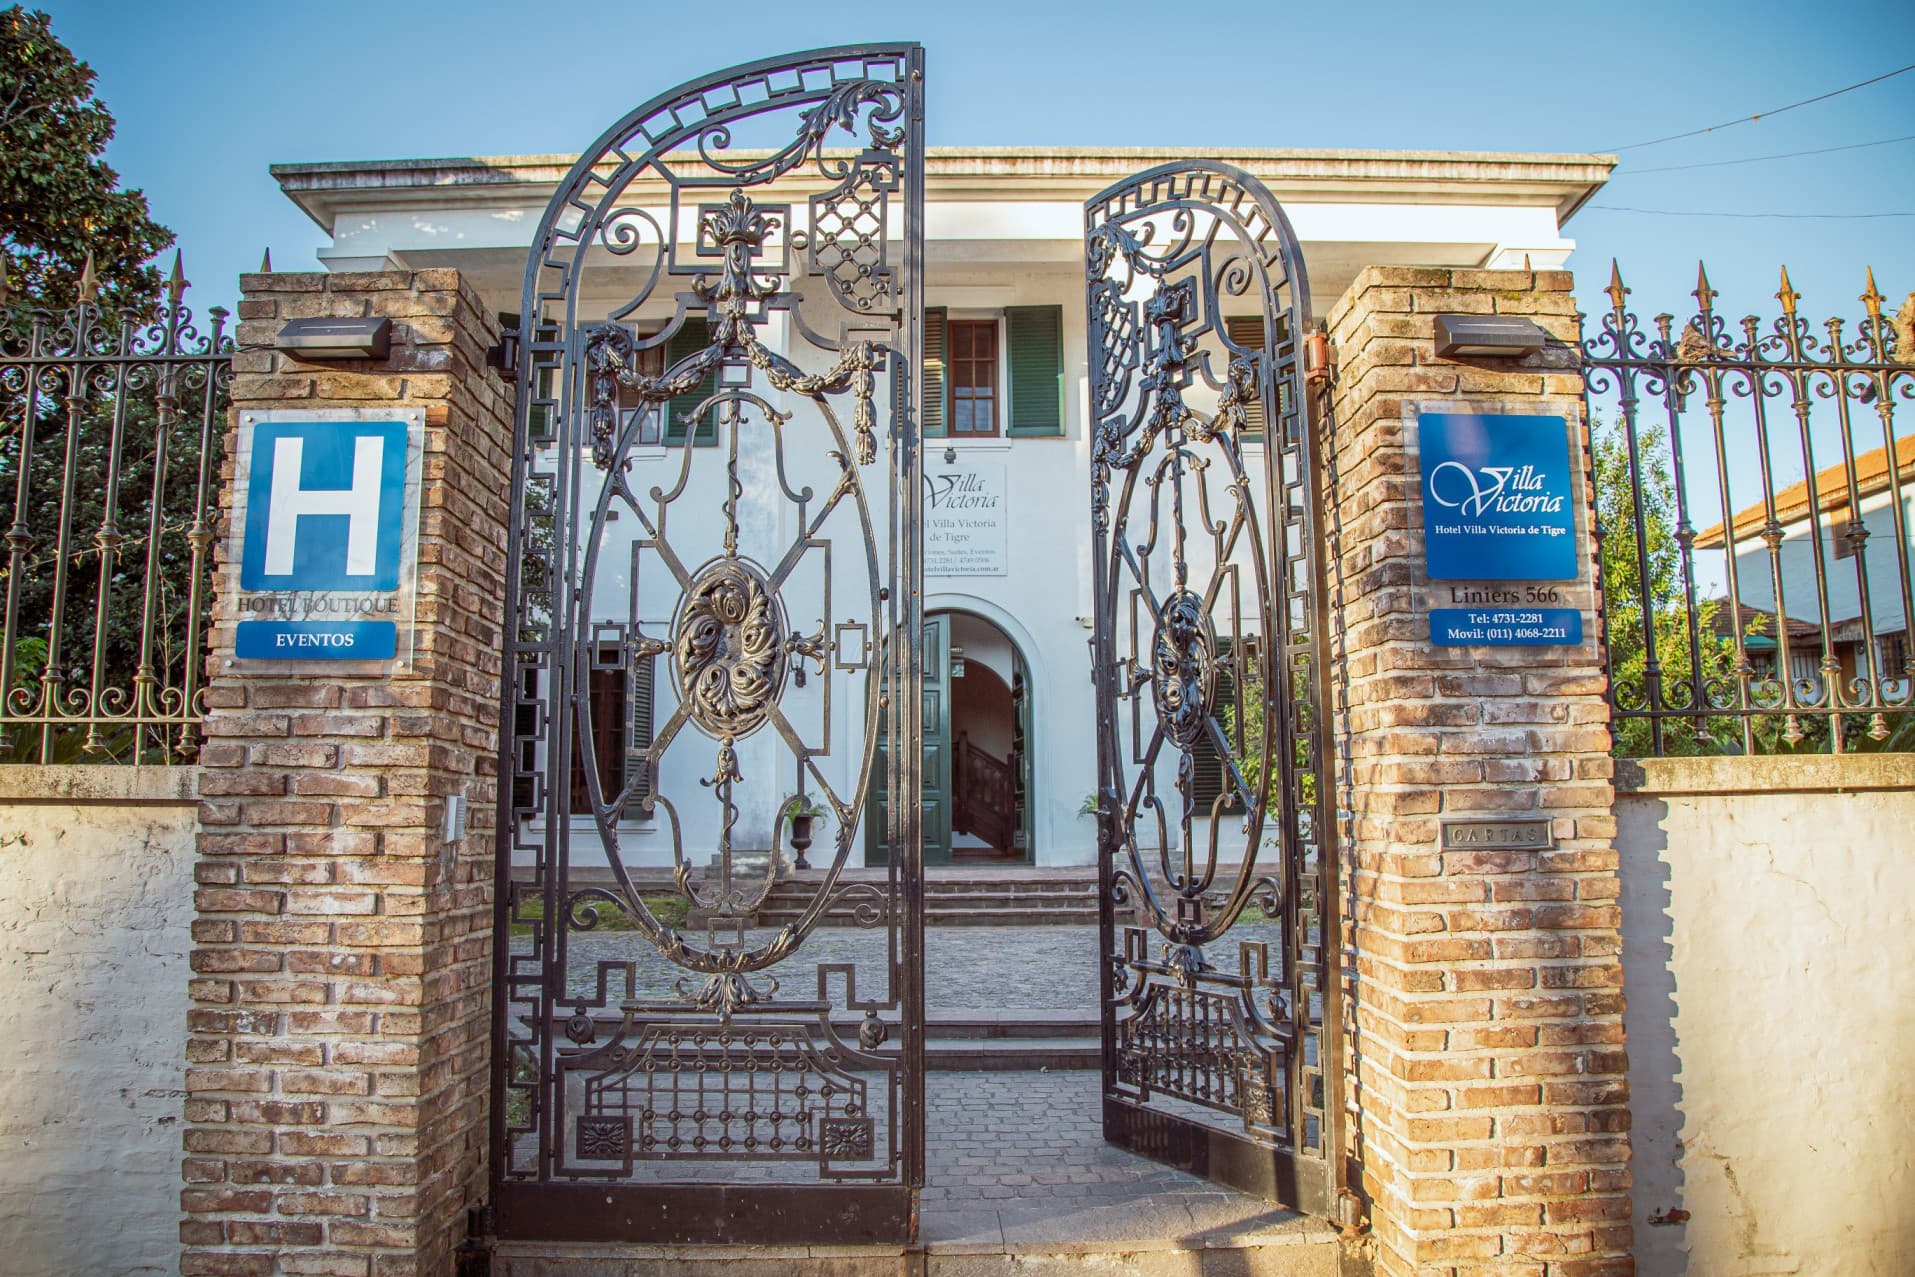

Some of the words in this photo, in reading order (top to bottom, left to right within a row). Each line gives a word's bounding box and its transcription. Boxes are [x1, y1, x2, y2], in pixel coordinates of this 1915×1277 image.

[937, 473, 986, 493] Villa
[1479, 464, 1546, 491] Villa
[1430, 461, 1564, 518] Victoria
[264, 436, 384, 576] H
[932, 519, 955, 528] Villa
[957, 519, 997, 528] Victoria
[1435, 525, 1461, 535] Hotel
[1463, 525, 1487, 535] Villa
[1489, 525, 1526, 535] Victoria
[1527, 525, 1540, 535] de
[1541, 525, 1566, 537] Tigre
[929, 532, 943, 542] de
[944, 532, 970, 544] Tigre
[1451, 586, 1520, 604] Liniers
[1526, 585, 1558, 604] 566
[237, 597, 297, 613] HOTEL
[303, 597, 401, 616] BOUTIQUE
[1468, 613, 1490, 624] Tel:
[1492, 613, 1543, 624] 4731-2281
[276, 633, 355, 648] EVENTOS
[1448, 628, 1484, 639] Movil:
[1487, 628, 1513, 641] (011)
[1515, 628, 1566, 639] 4068-2211
[1452, 828, 1538, 842] CARTAS
